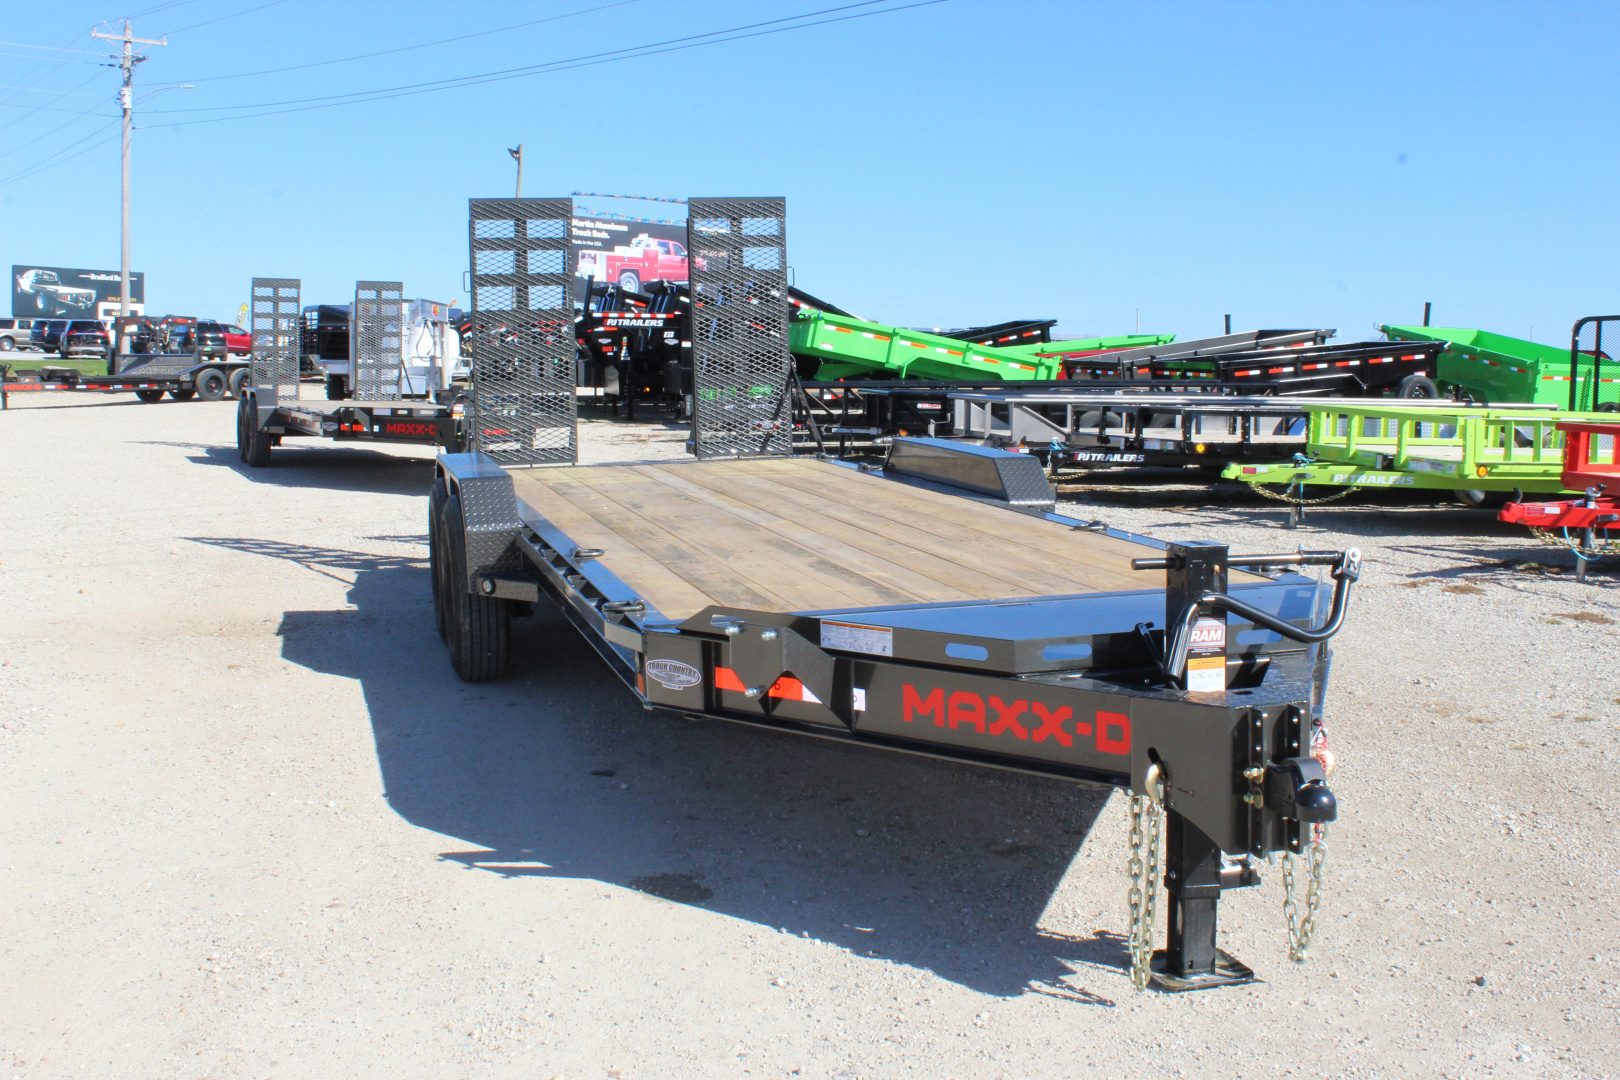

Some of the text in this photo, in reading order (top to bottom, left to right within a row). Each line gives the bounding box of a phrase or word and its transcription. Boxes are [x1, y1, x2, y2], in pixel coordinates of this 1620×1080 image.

[572, 219, 629, 232] Martin Aluminum
[572, 227, 611, 239] Truck Beds.
[1090, 454, 1145, 462] TRAILERS
[1348, 474, 1415, 485] TRAILERS
[1190, 629, 1223, 643] RAM
[649, 662, 696, 677] TRUCK COUNTRY
[903, 683, 1132, 756] MAXX-D
